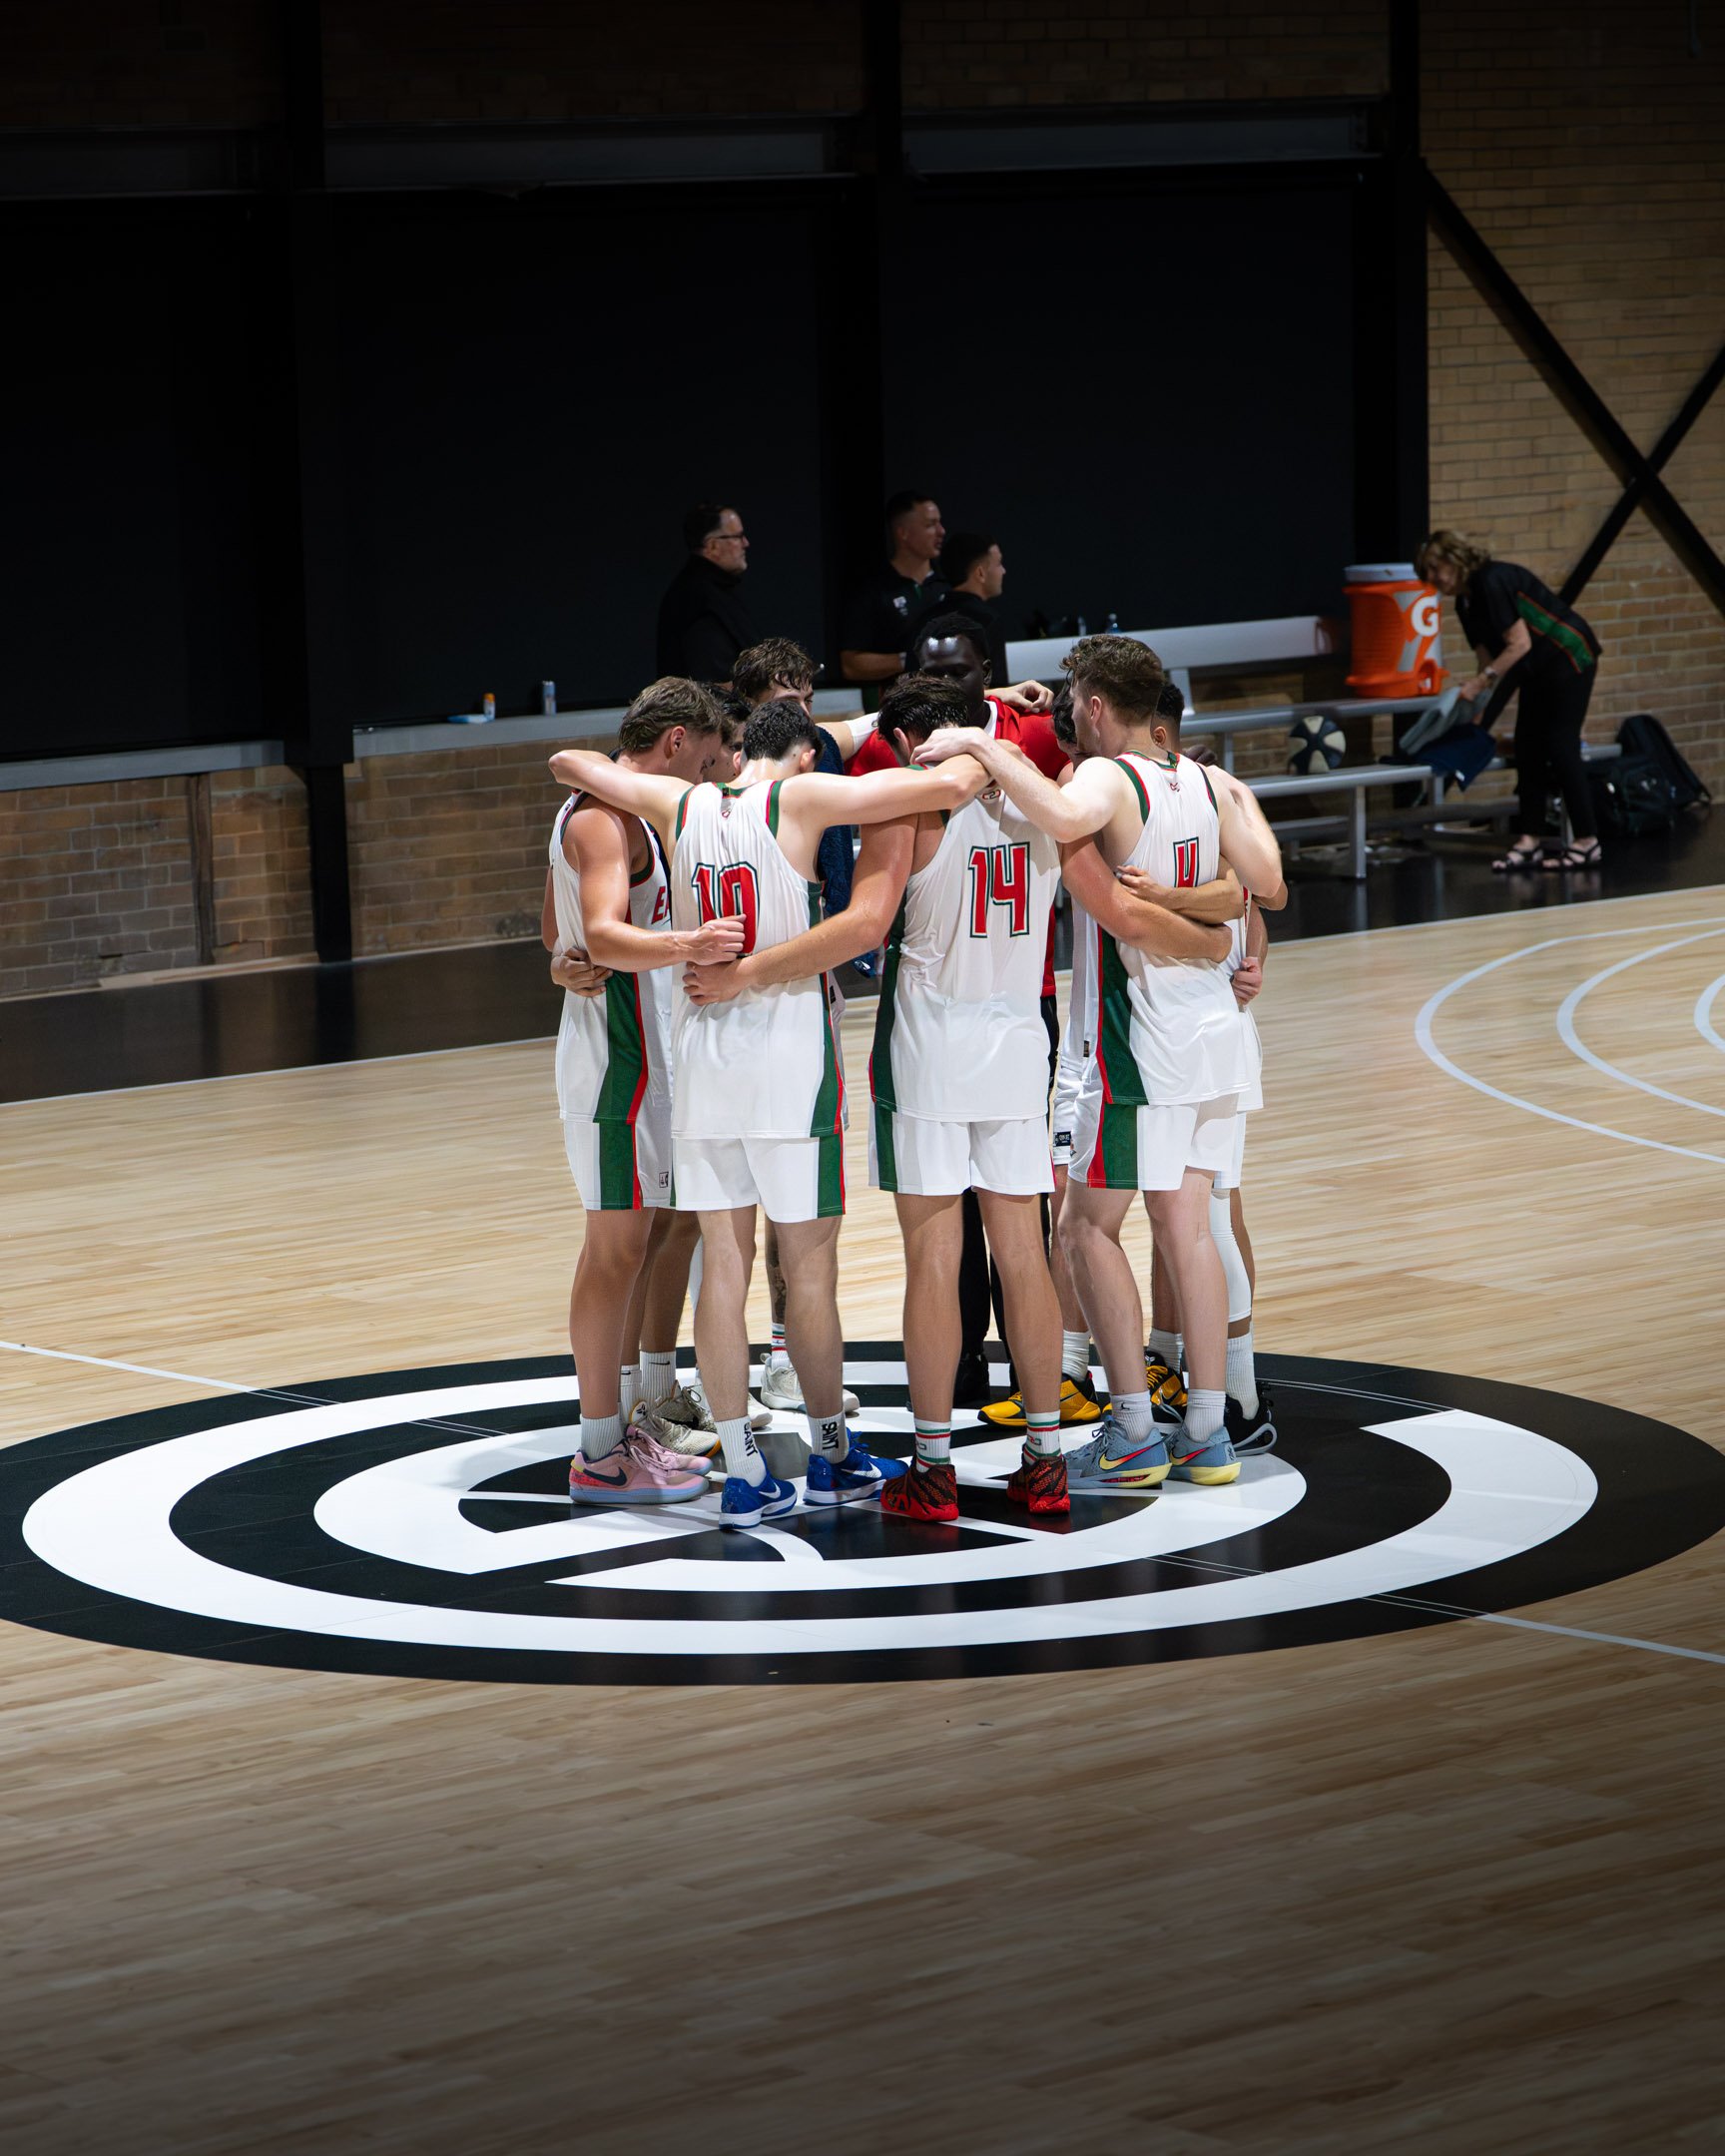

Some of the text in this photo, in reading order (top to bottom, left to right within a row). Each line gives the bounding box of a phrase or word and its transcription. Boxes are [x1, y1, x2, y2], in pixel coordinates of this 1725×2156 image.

[1411, 595, 1438, 637] G
[691, 861, 760, 958] 10
[968, 841, 1030, 938] 14
